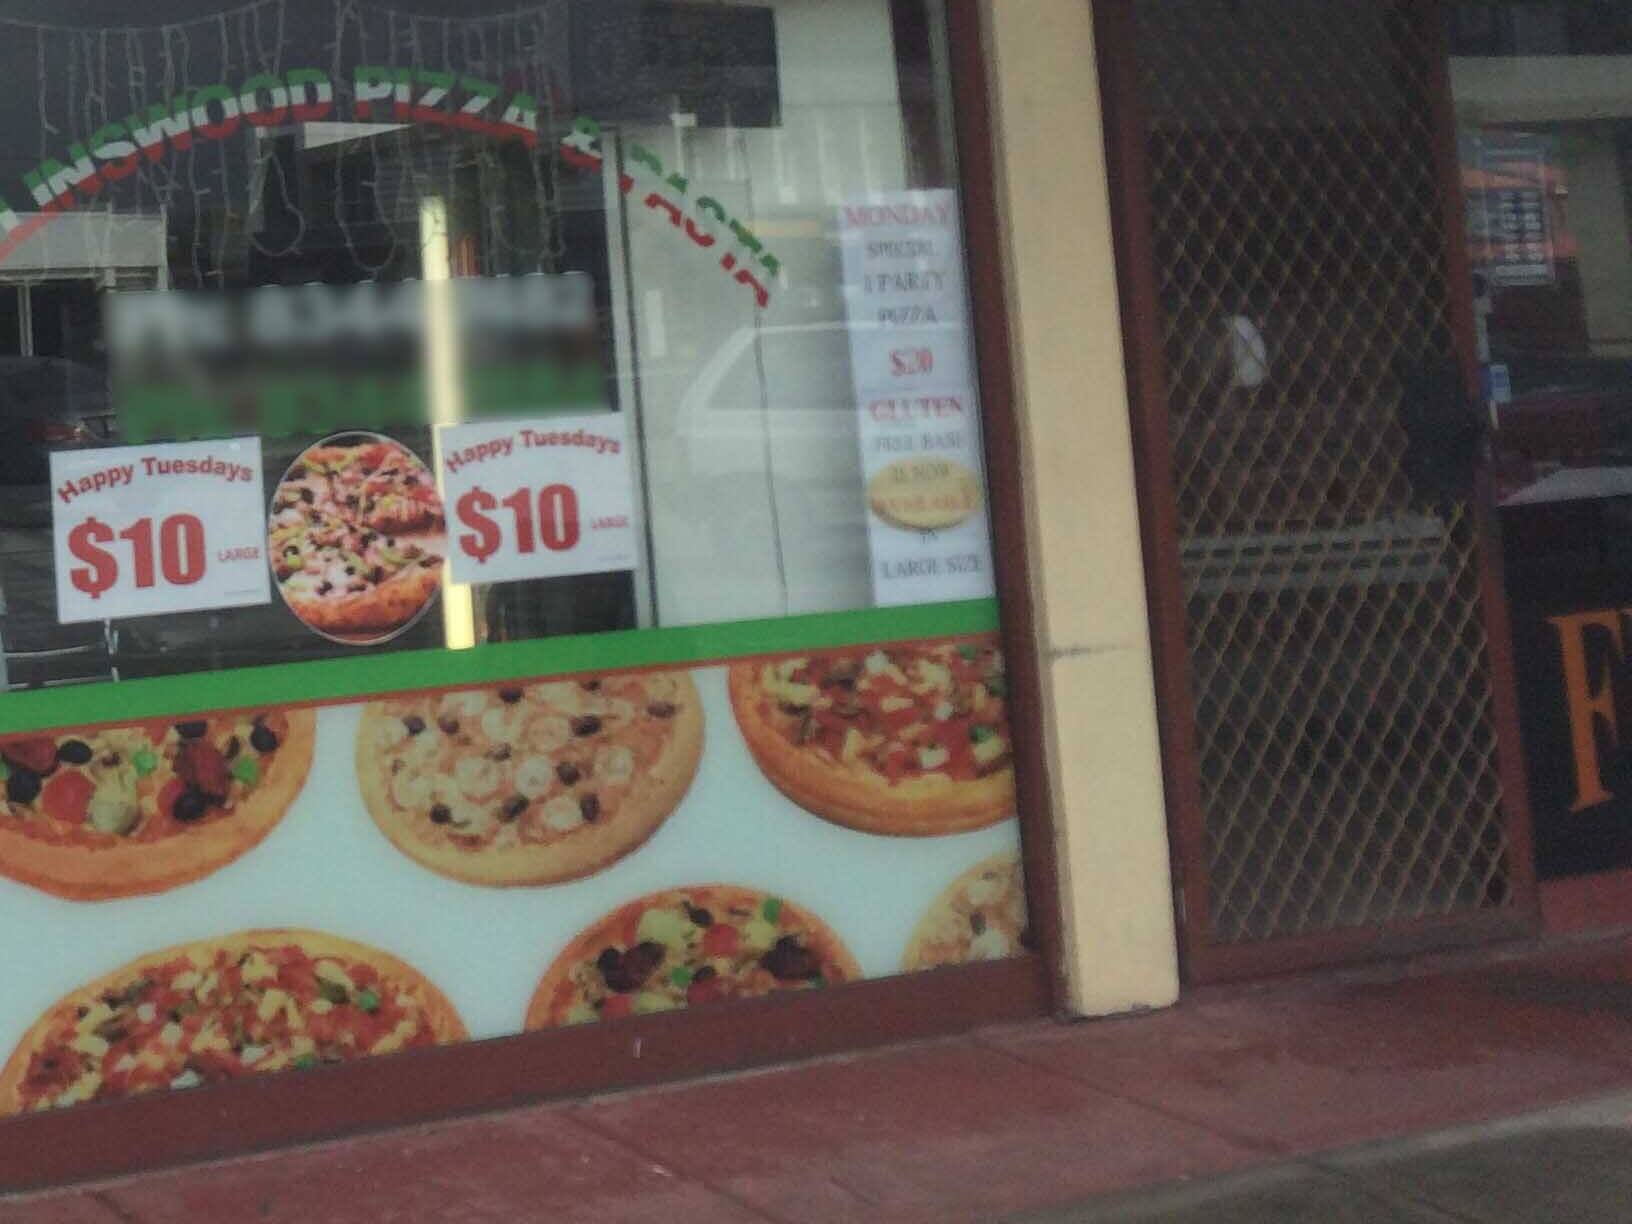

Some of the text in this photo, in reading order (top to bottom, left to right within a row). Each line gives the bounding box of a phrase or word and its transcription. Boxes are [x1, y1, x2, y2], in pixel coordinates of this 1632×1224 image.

[353, 65, 543, 149] PIZZA
[57, 455, 255, 503] Happy Tuesdays
[446, 429, 622, 473] Happy Tuesdays
[67, 513, 208, 600] $10
[455, 483, 581, 565] $10
[1546, 607, 1632, 813] F
